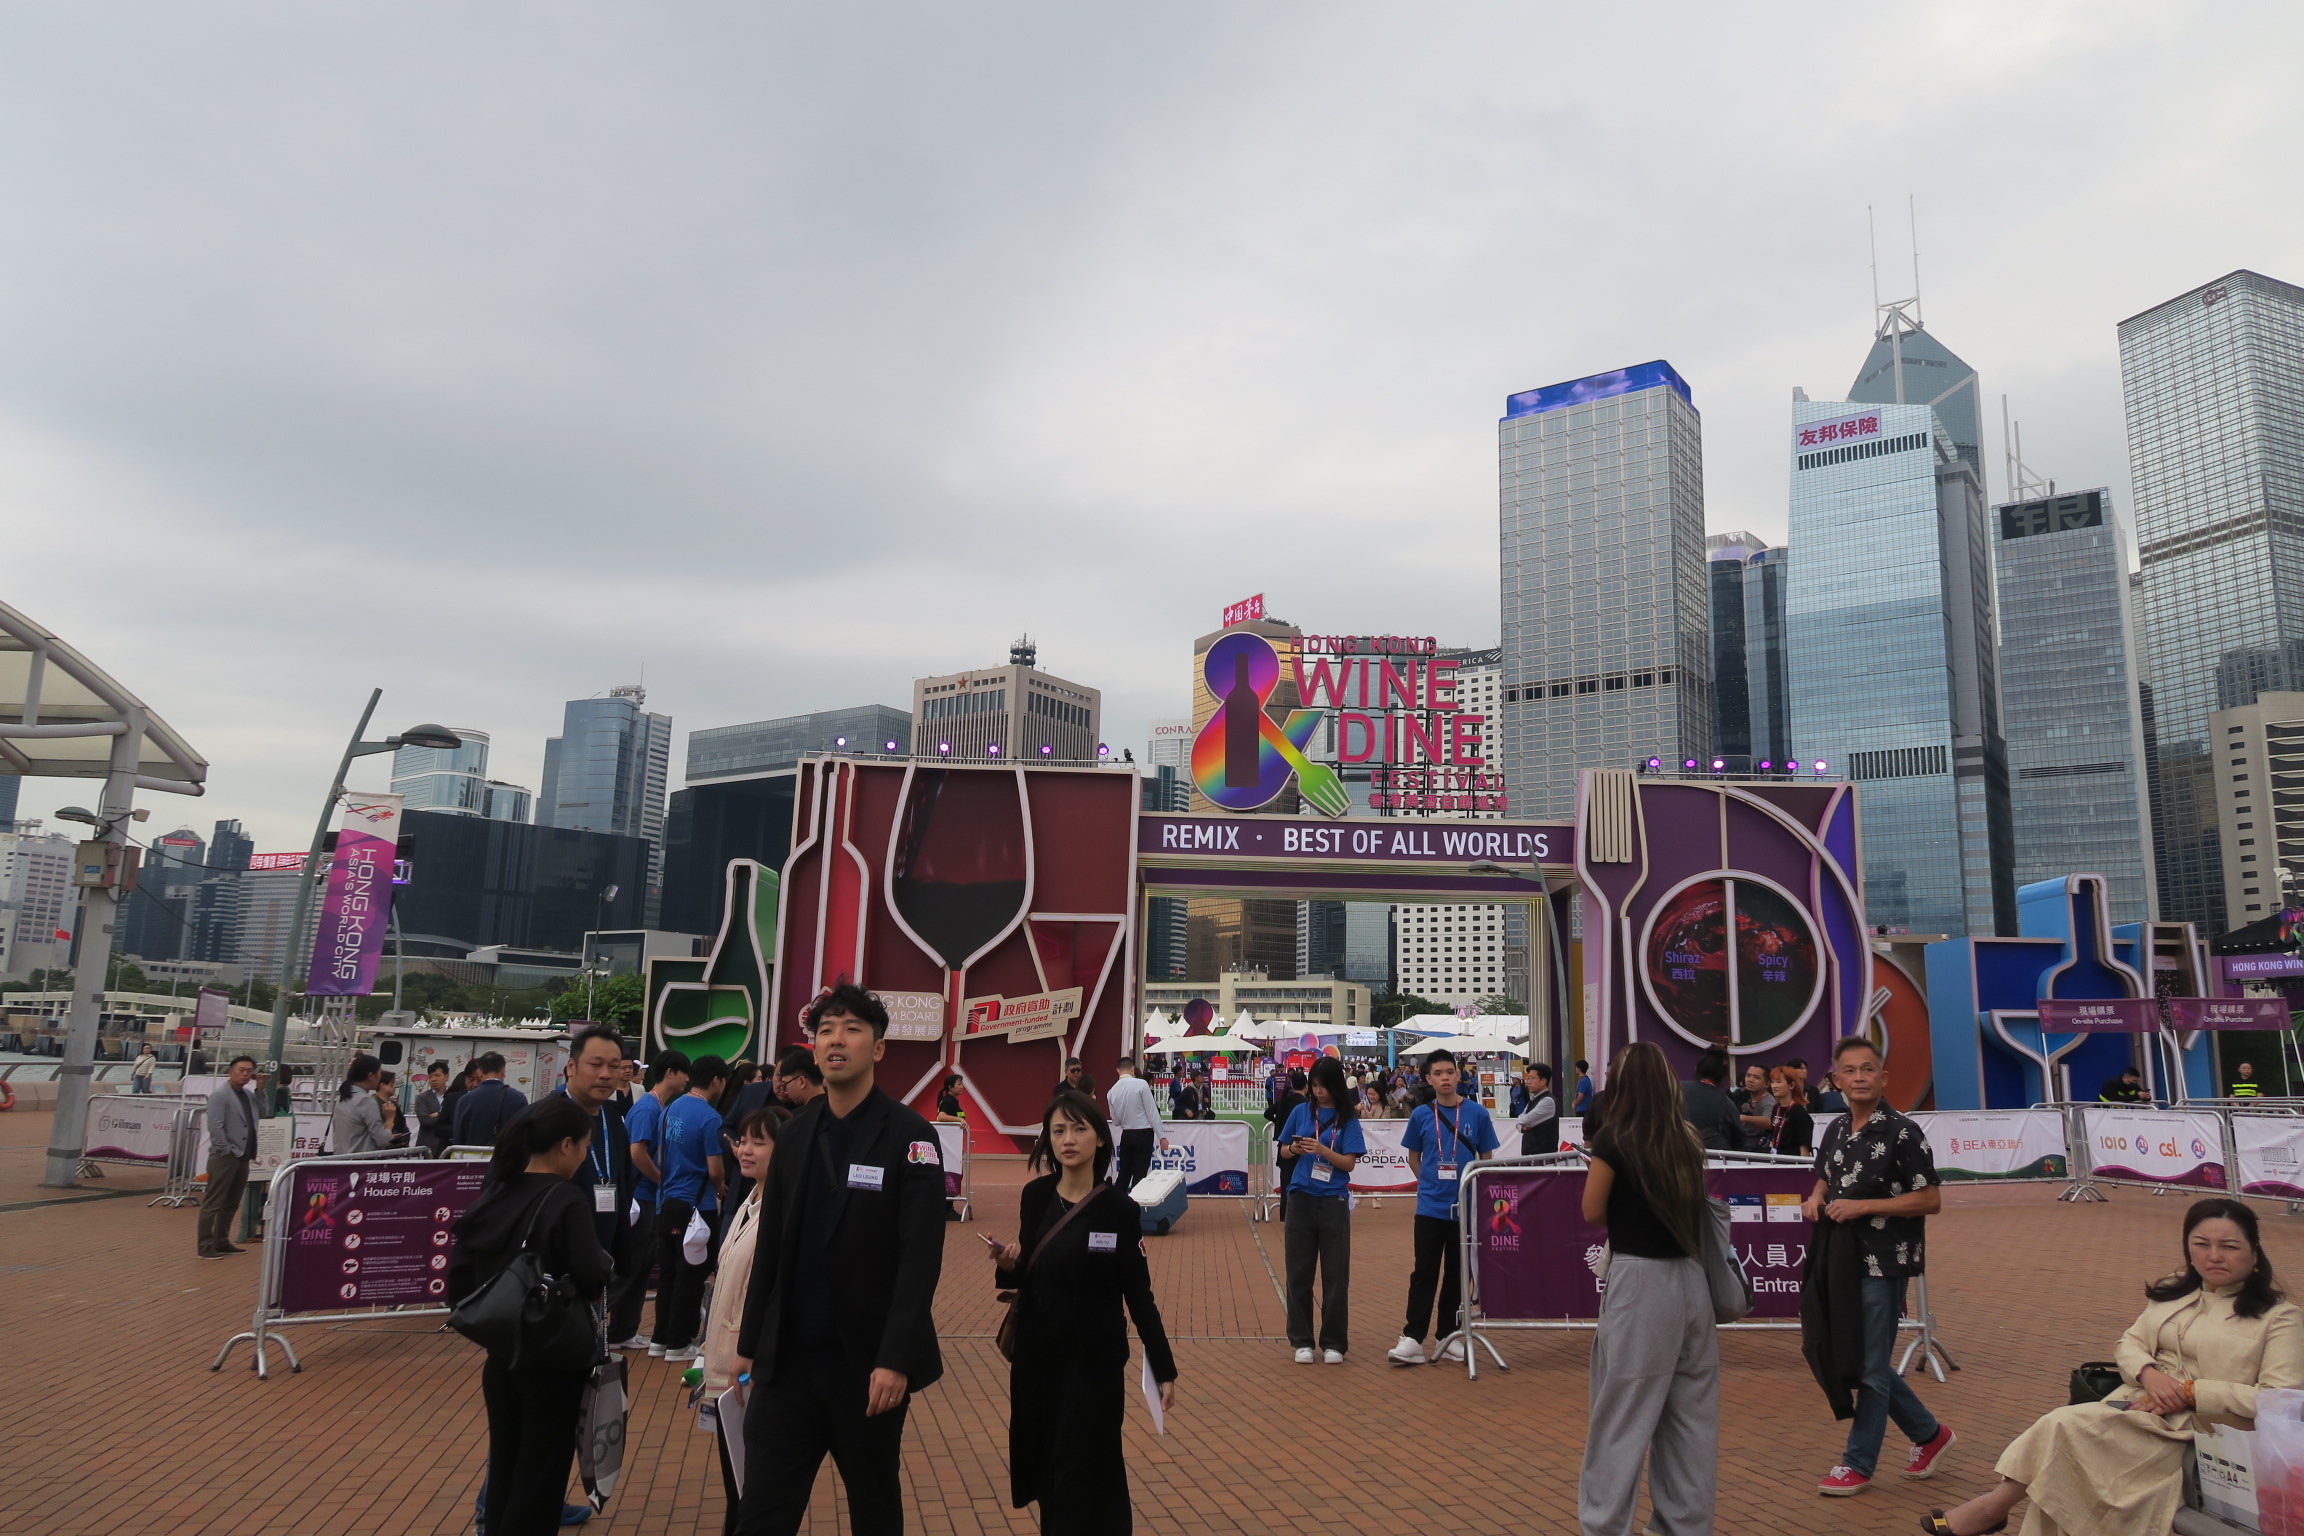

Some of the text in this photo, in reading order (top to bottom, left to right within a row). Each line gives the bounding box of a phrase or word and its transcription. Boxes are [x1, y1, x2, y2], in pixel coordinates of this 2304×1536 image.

[1799, 416, 1878, 446] 友邦保險
[1291, 634, 1437, 654] HONG KONG
[1404, 664, 1427, 673] BNK
[1291, 656, 1460, 711] WINE
[1155, 724, 1192, 735] CONRA
[1338, 712, 1486, 767] DINE
[1370, 770, 1507, 791] FESTIVAL
[1162, 824, 1549, 858] REMIX BEST OF ALL WORLDS
[331, 847, 360, 979] ASIA'S WORLD CITY
[341, 848, 377, 980] HONG KONG
[1665, 951, 1701, 964] Shiraz
[1758, 953, 1789, 968] Spicy
[2232, 959, 2304, 973] HONG KONG WIN
[1671, 968, 1696, 980] 西拉
[1762, 970, 1786, 982] 辛辣
[897, 995, 941, 1009] KONG
[1003, 998, 1051, 1017] 政府資助
[1052, 999, 1074, 1015] 計劃
[900, 1011, 940, 1022] BOARD
[980, 1014, 1048, 1032] Government-funded
[2071, 1017, 2123, 1025] On-site Purchase
[1015, 1021, 1053, 1034] programme
[1963, 1140, 1988, 1150] BEA
[2159, 1137, 2182, 1157] csl.
[365, 1171, 416, 1184] 現場守則
[307, 1182, 338, 1192] WINE
[363, 1186, 433, 1197] House Rules
[1489, 1188, 1518, 1199] WINE
[301, 1228, 333, 1241] DINE
[1491, 1235, 1519, 1246] DINE
[1752, 1276, 1802, 1293] Entra
